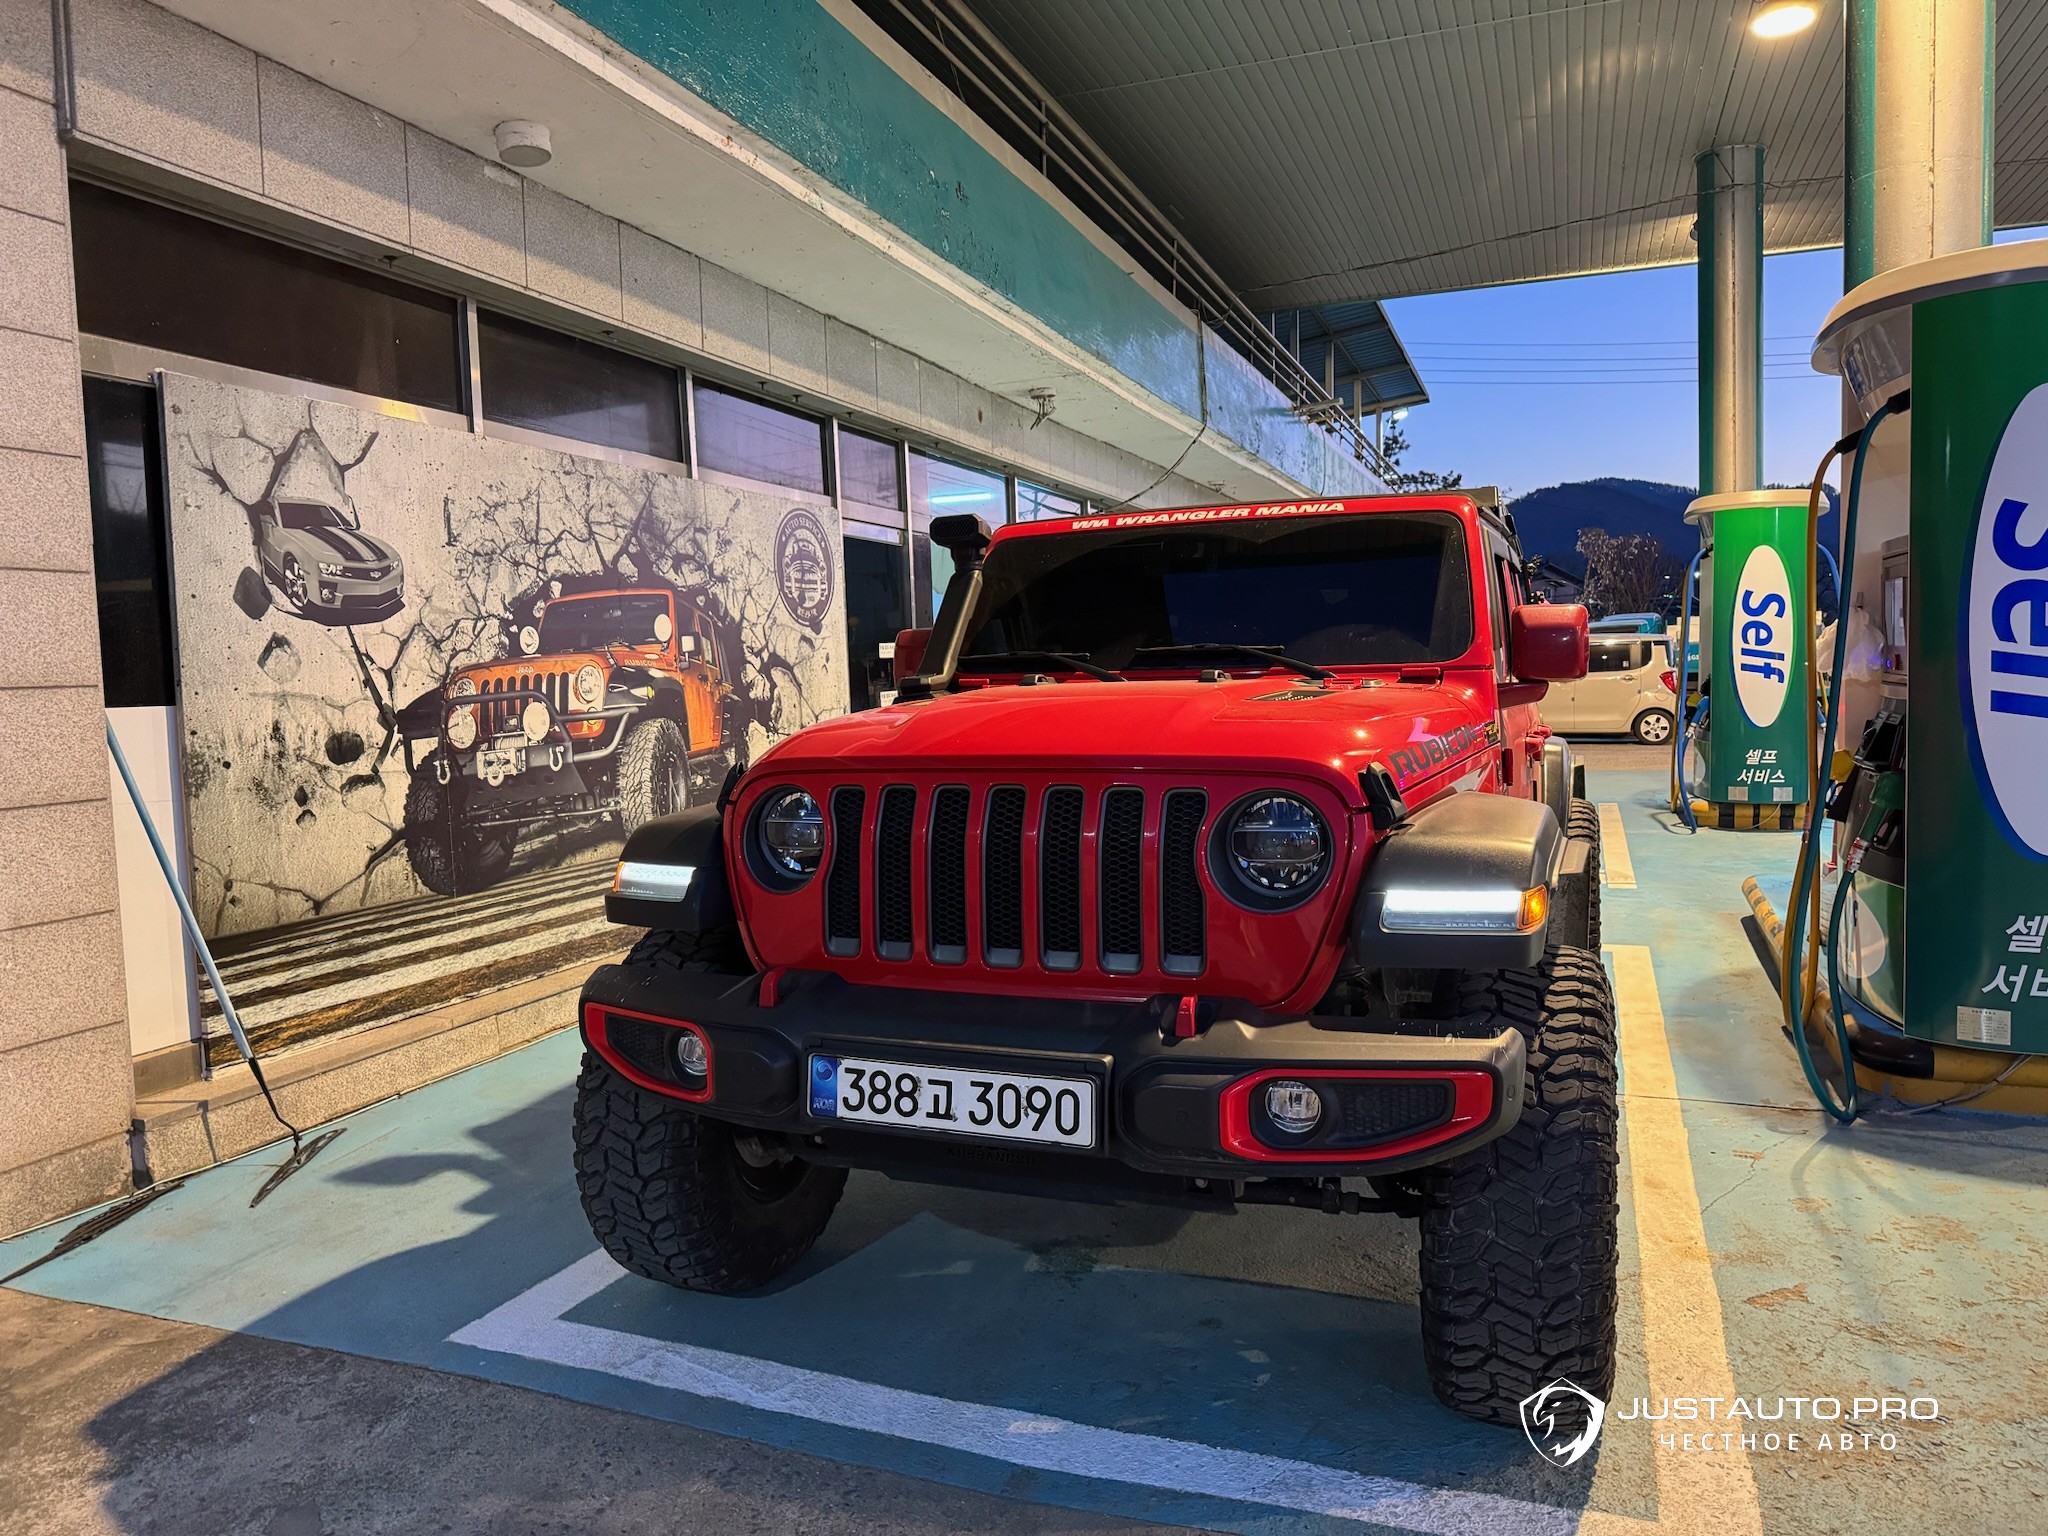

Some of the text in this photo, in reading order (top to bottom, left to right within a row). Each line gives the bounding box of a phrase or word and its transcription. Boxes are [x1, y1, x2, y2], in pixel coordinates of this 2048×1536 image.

[1116, 508, 1250, 526] WRANGLER
[1254, 502, 1345, 516] MANIA
[784, 517, 800, 537] AUTO
[1741, 589, 1786, 684] Self
[515, 665, 535, 674] Jeep
[624, 658, 657, 668] RUBICON
[1388, 722, 1478, 779] RUBICON
[1745, 748, 1778, 765] 셀프
[1736, 768, 1786, 785] 서비스
[2005, 914, 2048, 954] 셀
[813, 1096, 836, 1111] KOR
[842, 1067, 1081, 1136] 388고 3090
